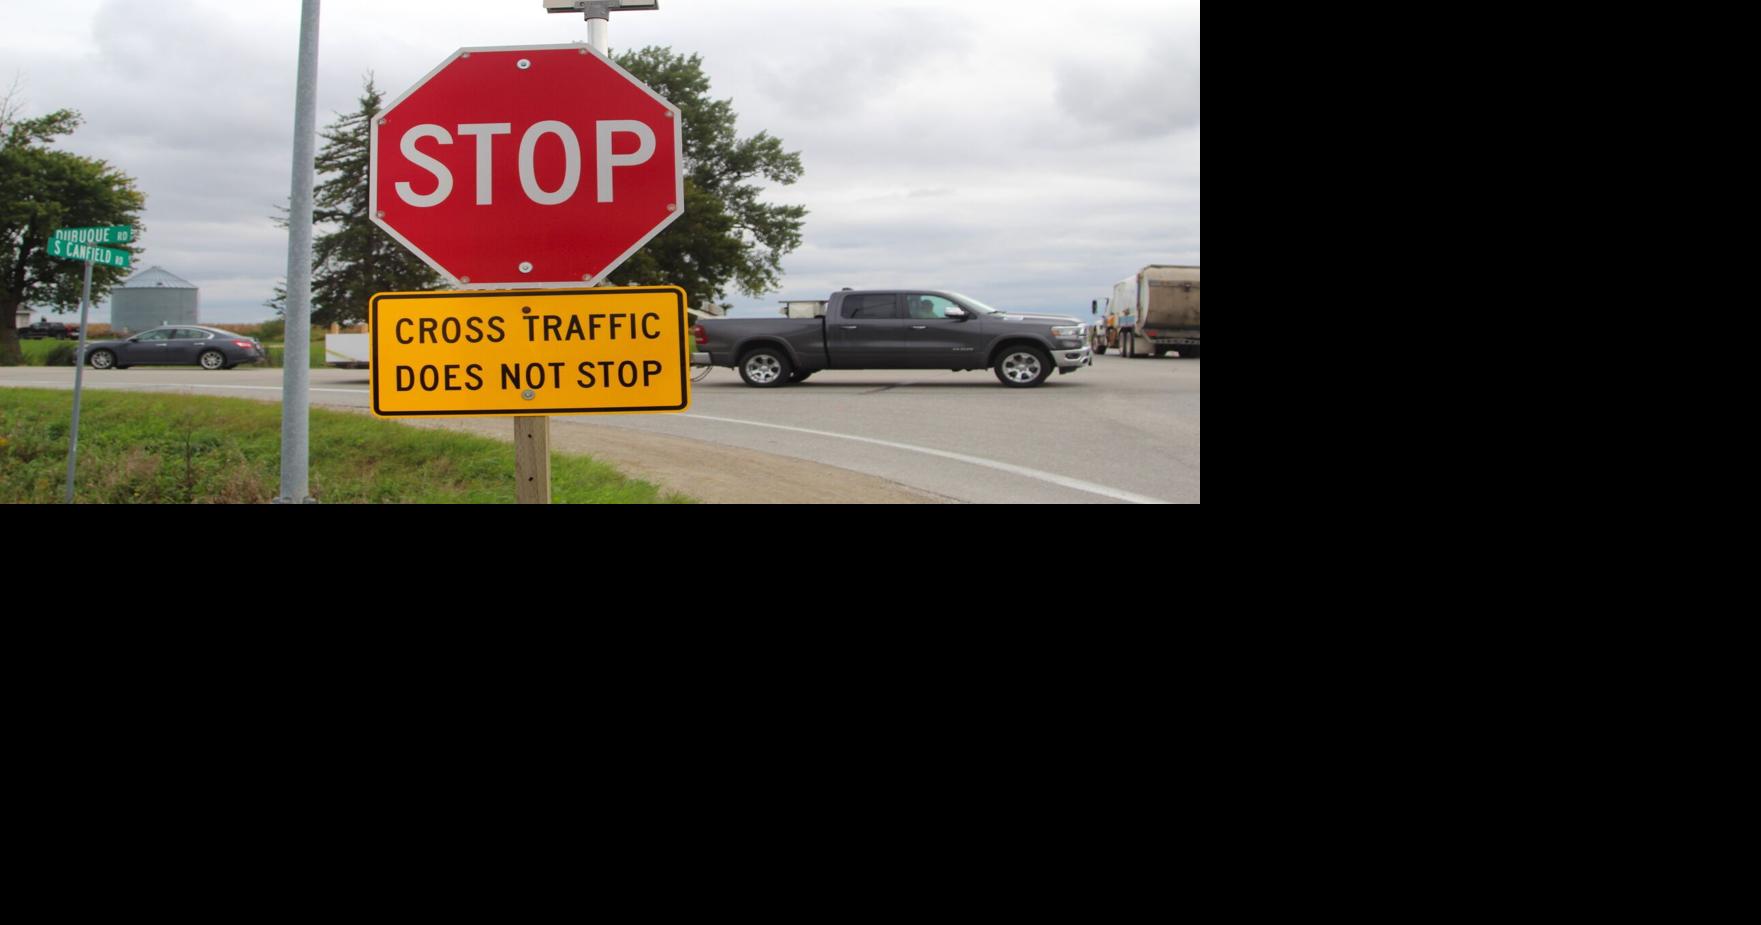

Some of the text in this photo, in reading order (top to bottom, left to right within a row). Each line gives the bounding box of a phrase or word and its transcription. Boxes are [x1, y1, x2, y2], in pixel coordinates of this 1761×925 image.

[395, 120, 656, 207] STOP
[56, 228, 128, 243] DUBUQUE RD
[54, 240, 124, 266] S CANFIELD RD
[395, 312, 661, 344] CROSS TRAFFIC
[396, 360, 663, 392] DOES NOT STOP
